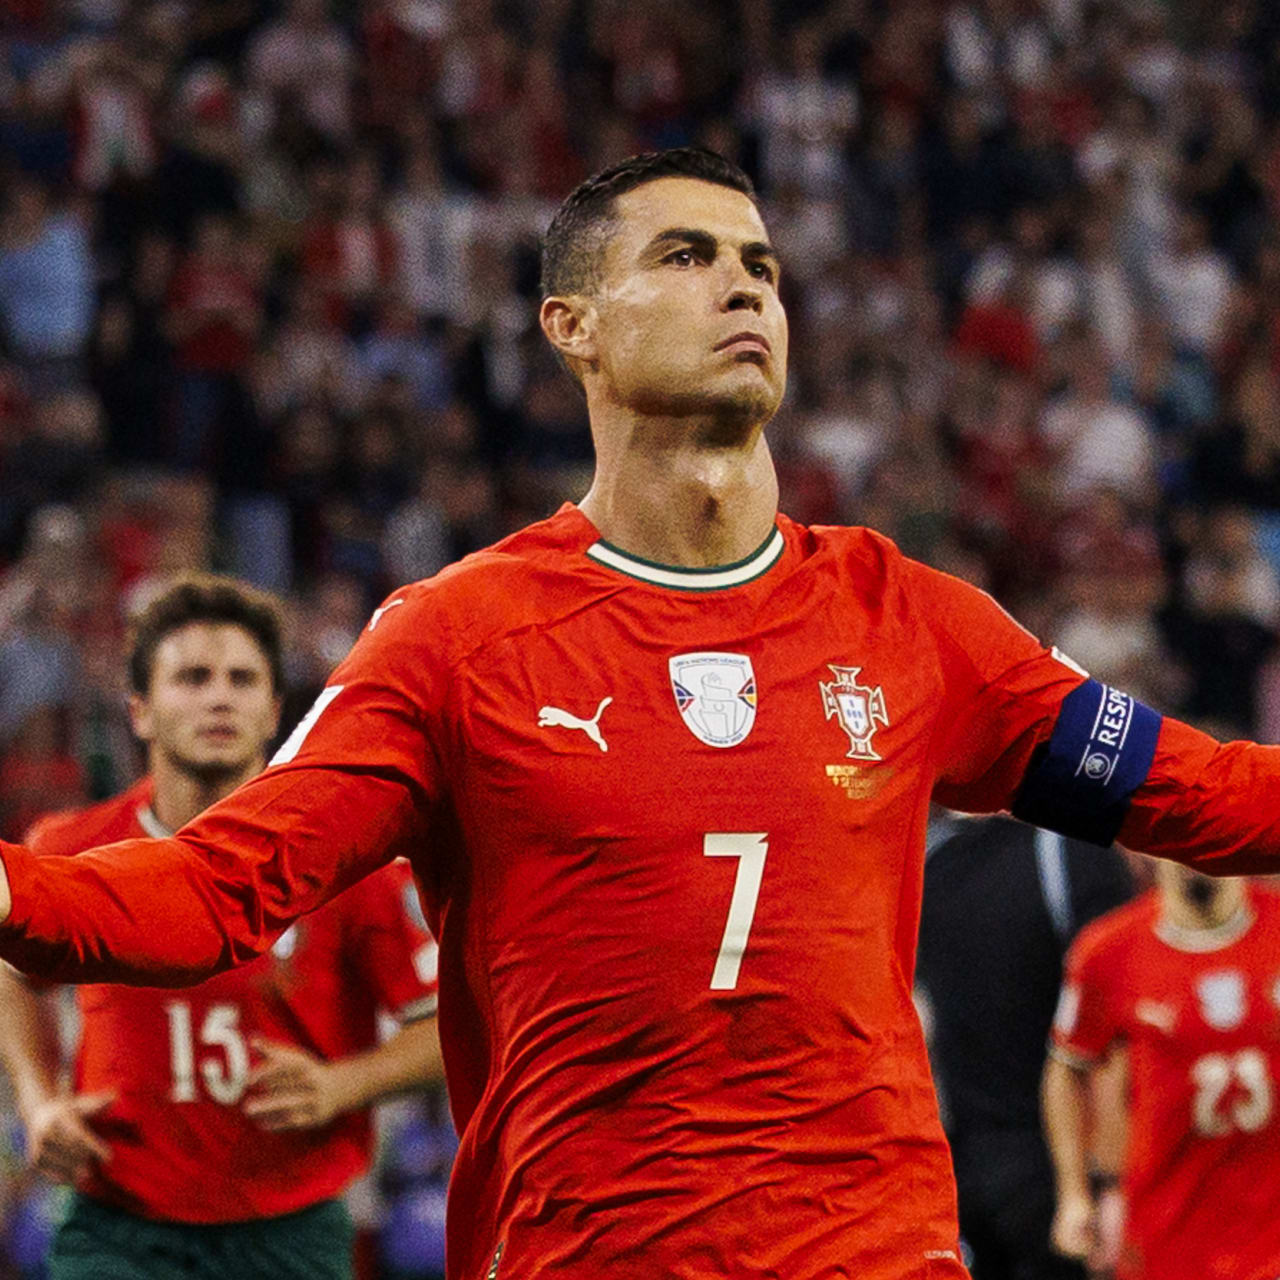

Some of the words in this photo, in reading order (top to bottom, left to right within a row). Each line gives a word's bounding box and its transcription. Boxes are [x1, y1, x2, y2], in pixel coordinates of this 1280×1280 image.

[703, 832, 769, 990] 7
[164, 998, 249, 1105] 15
[1190, 1048, 1273, 1138] 23
